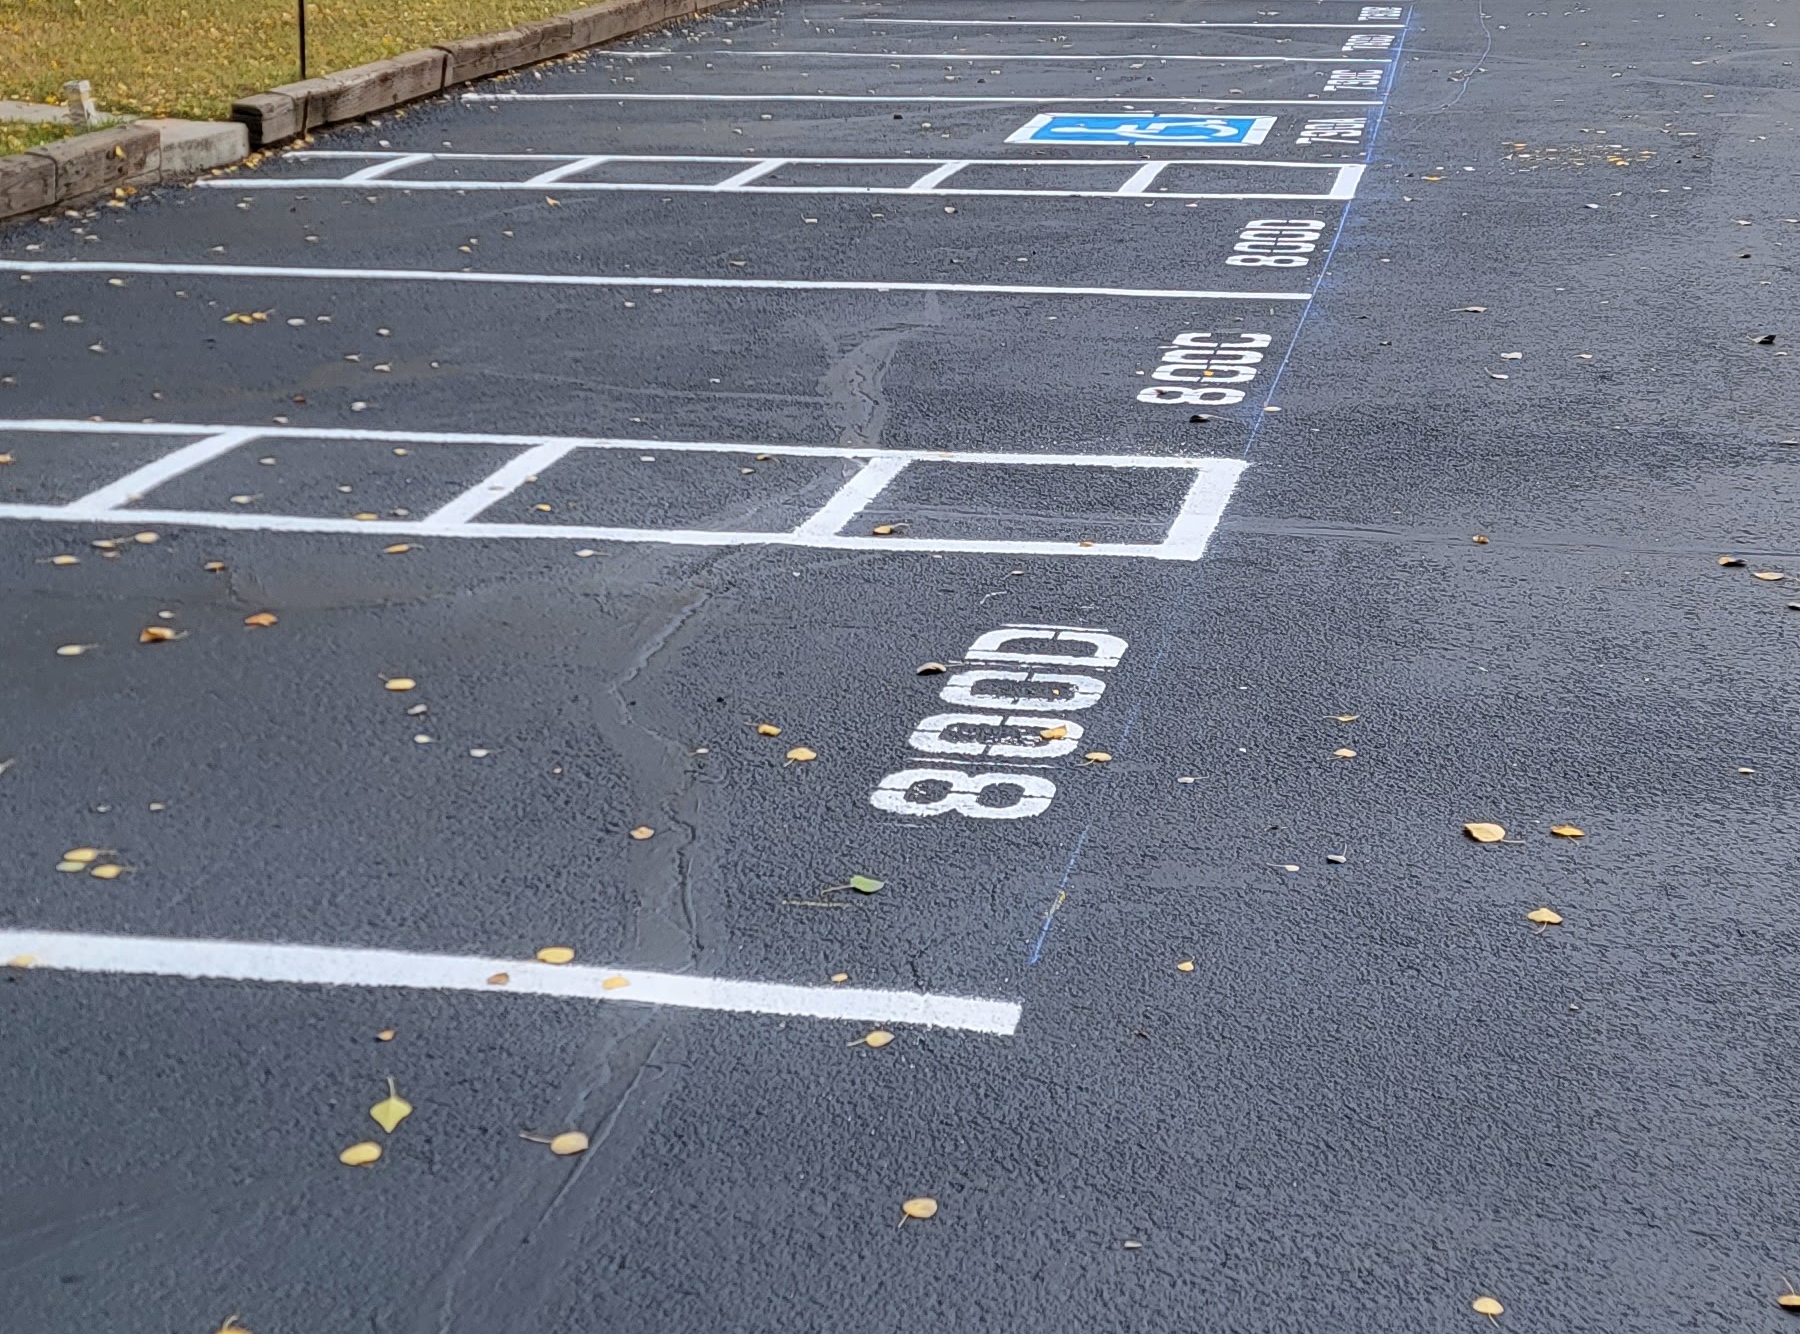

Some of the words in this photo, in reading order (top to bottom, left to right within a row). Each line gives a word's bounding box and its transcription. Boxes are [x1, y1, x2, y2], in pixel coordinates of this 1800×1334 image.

[1323, 69, 1383, 92] 790C
[1295, 117, 1368, 145] 790A
[1225, 219, 1326, 267] 800D
[1136, 332, 1273, 406] 800C
[870, 625, 1129, 819] 800D
